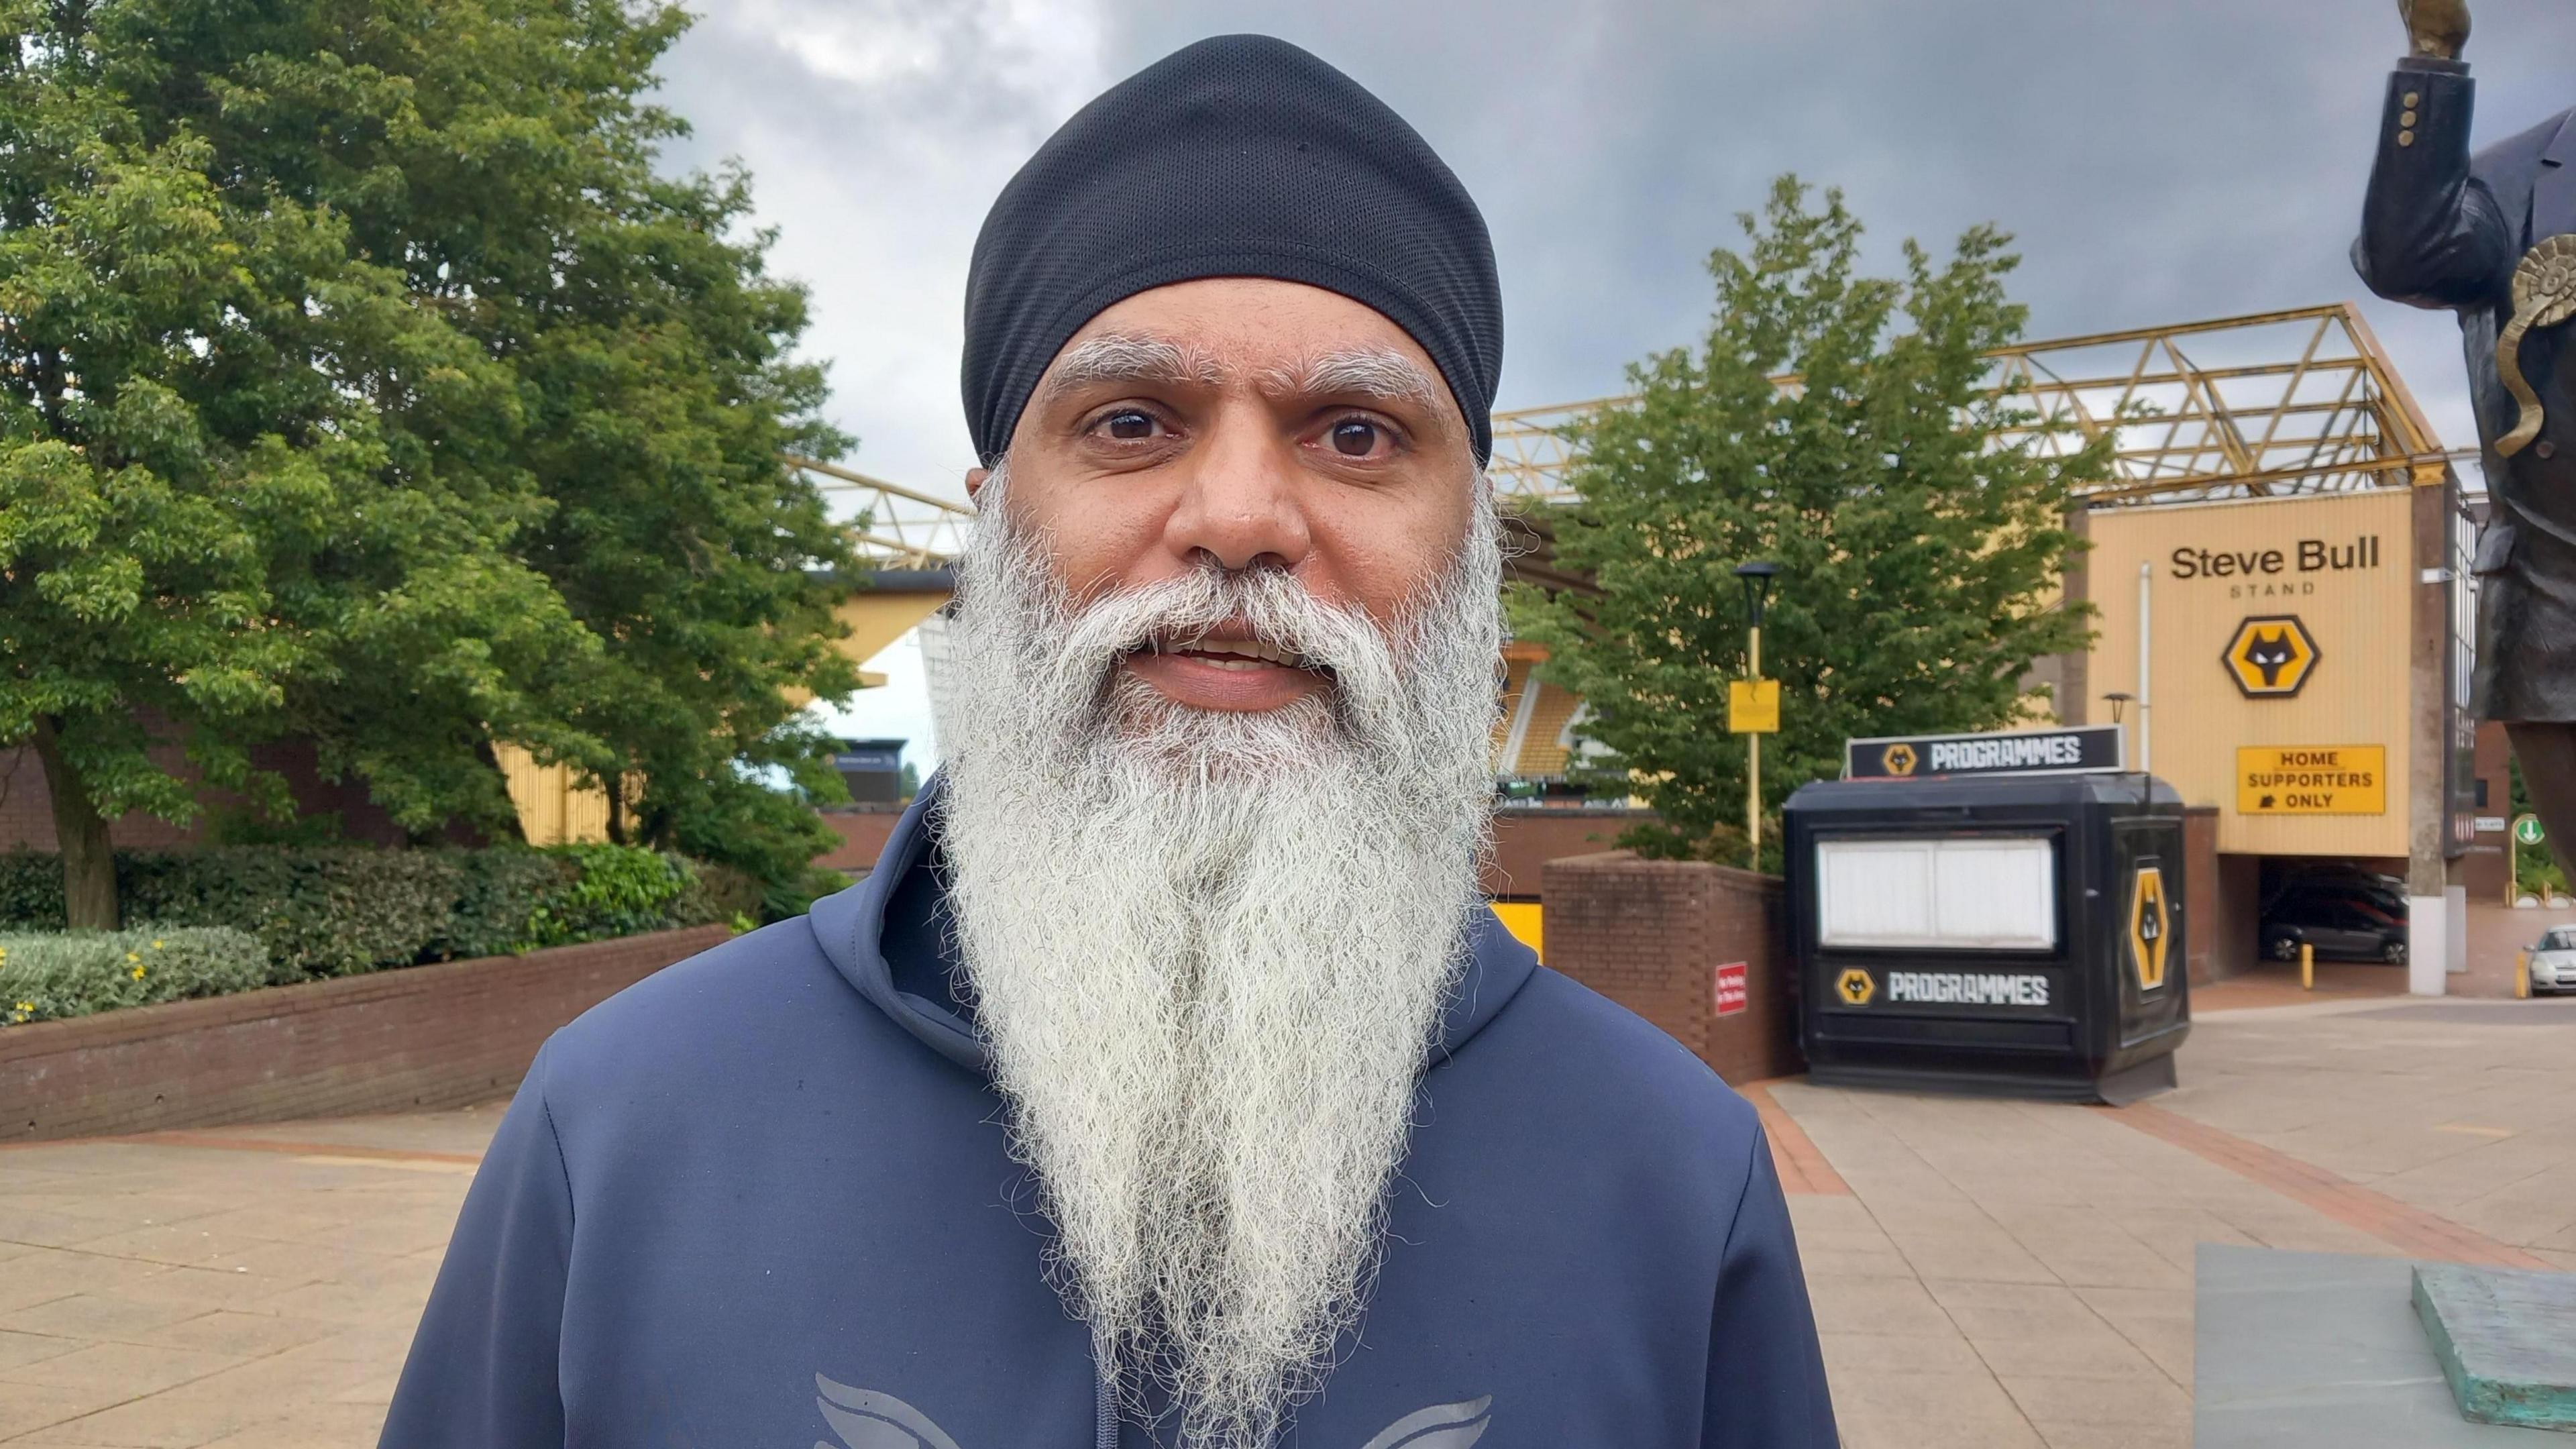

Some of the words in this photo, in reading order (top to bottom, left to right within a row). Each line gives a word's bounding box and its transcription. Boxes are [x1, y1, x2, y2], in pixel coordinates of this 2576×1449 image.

[2171, 547, 2284, 578] Steve
[2298, 535, 2379, 571] Bull
[2230, 581, 2314, 598] STAND
[1931, 735, 2082, 770] PROGRAMMES
[2281, 751, 2338, 766] HOME
[2248, 773, 2373, 788] SUPPORTERS
[2286, 793, 2333, 808] ONLY
[1889, 972, 2049, 1006] PROGRAMMES
